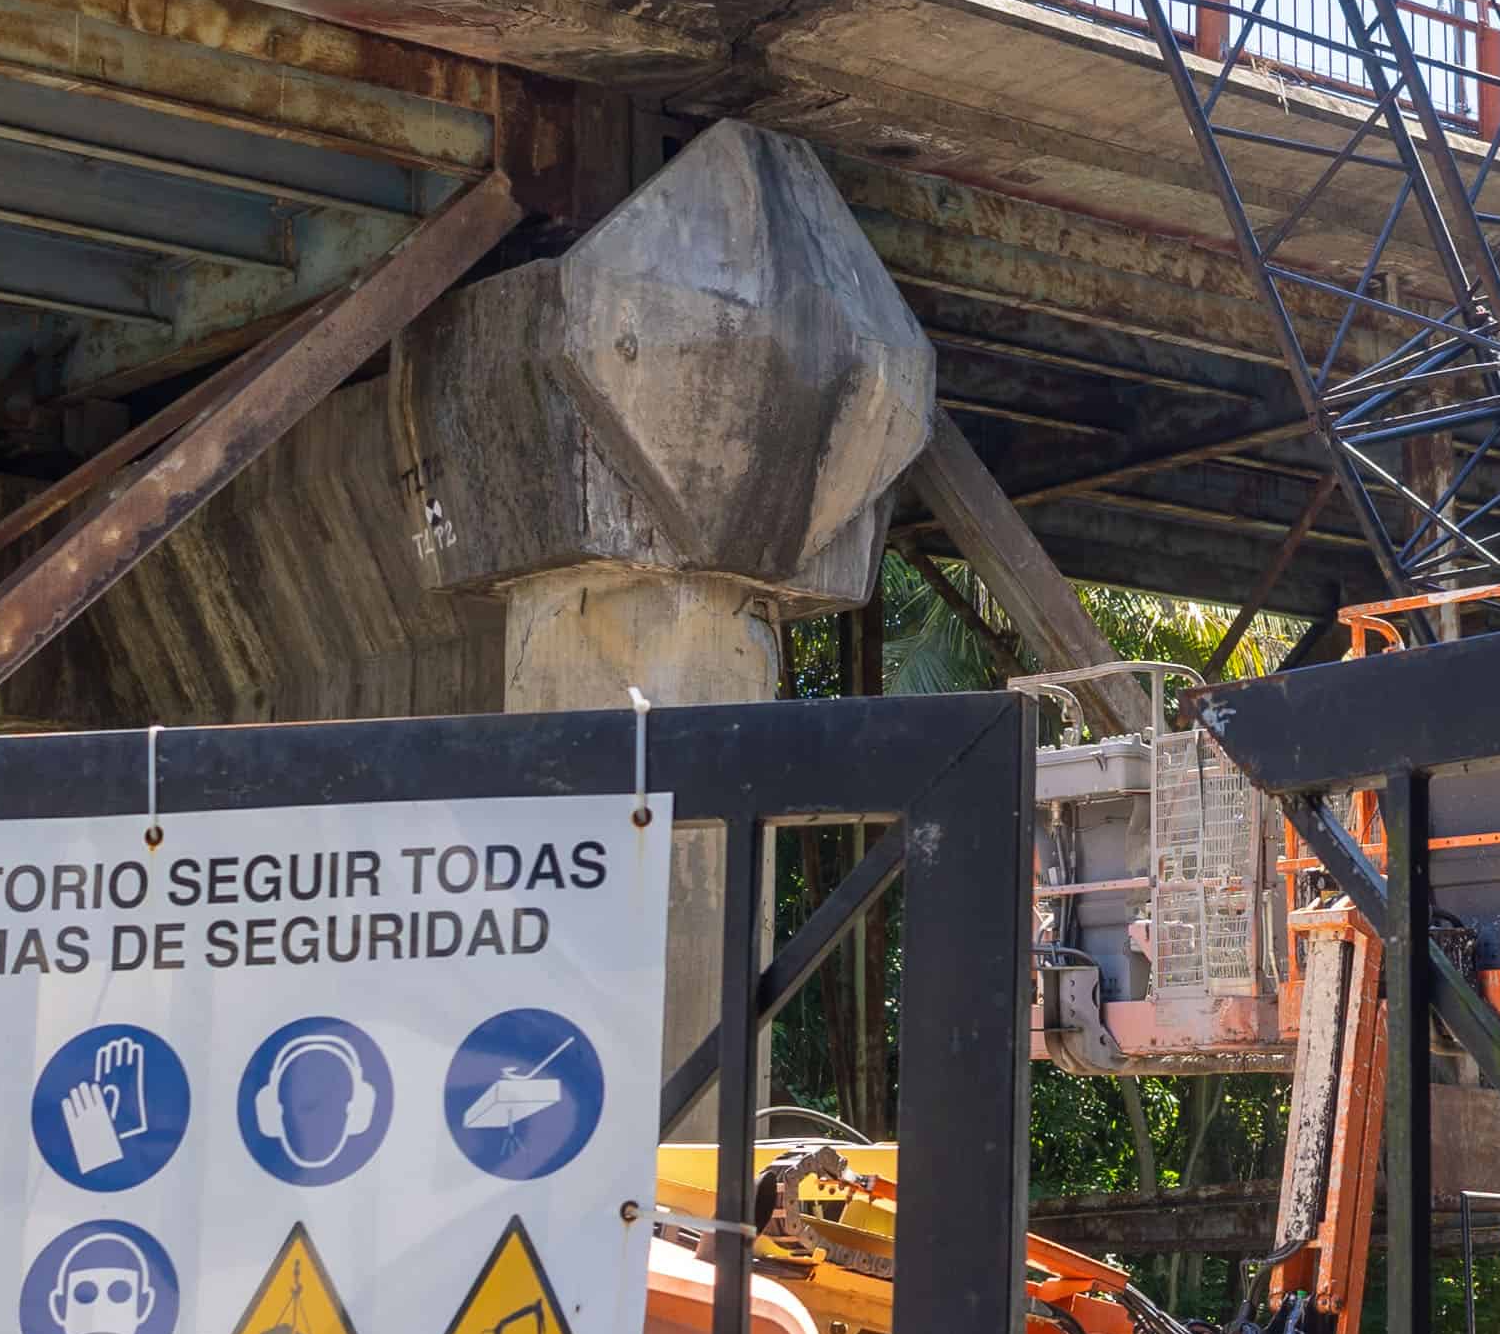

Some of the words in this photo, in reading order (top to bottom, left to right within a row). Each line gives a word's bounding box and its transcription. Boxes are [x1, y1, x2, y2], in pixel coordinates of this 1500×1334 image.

[412, 520, 457, 560] T1P2
[168, 851, 380, 906] SEGUIR
[401, 841, 606, 894] TODAS
[112, 923, 185, 971] DE
[205, 907, 549, 968] SEGURIDAD
